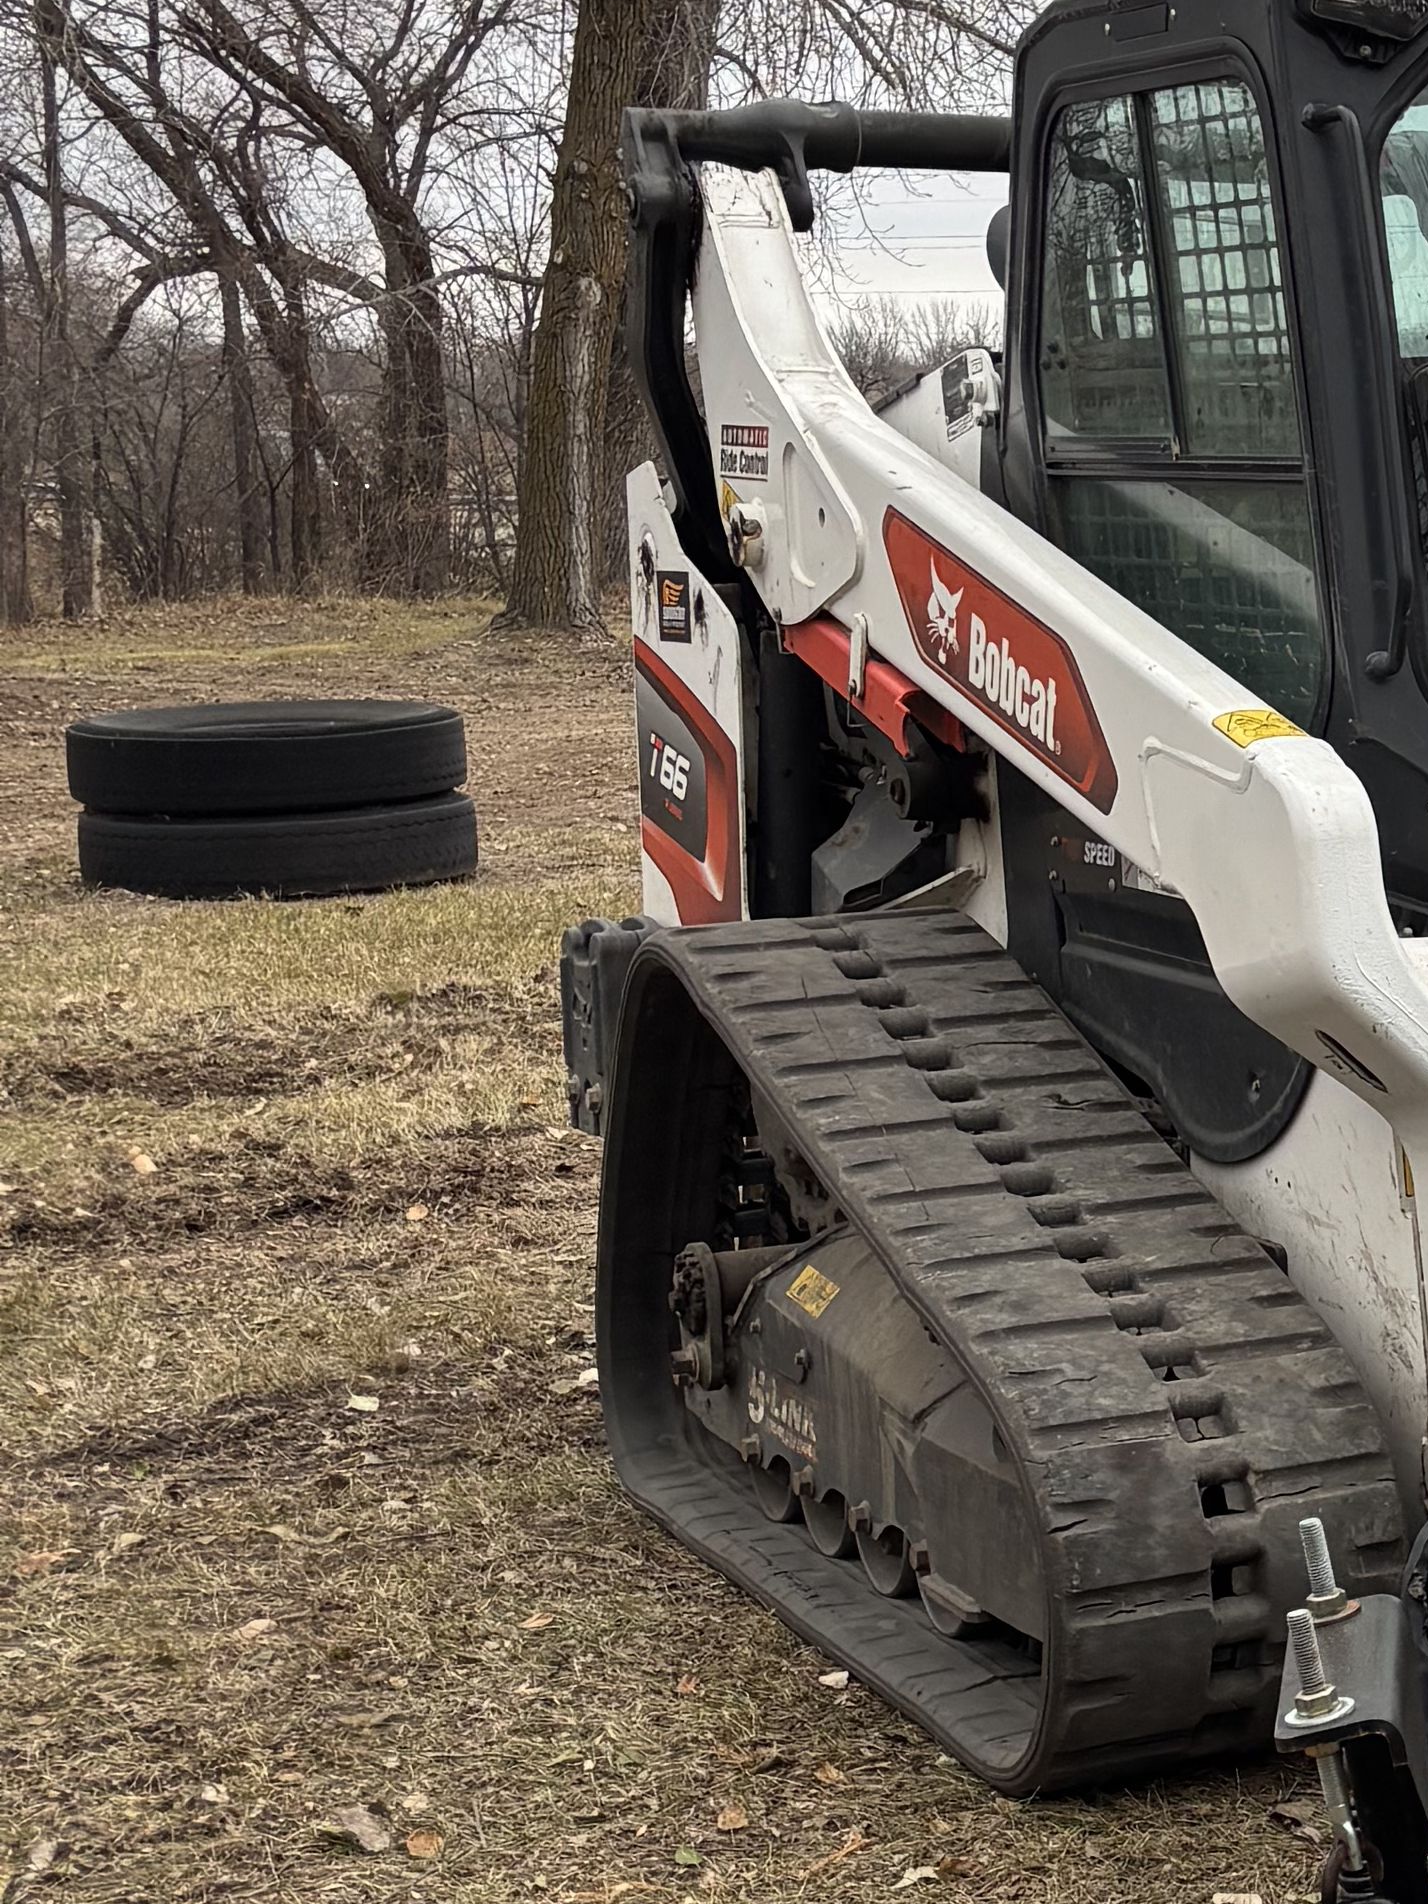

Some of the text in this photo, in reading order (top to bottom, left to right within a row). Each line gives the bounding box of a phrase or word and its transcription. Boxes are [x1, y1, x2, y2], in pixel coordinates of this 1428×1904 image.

[722, 428, 768, 446] AUTOMATIC
[720, 447, 738, 473] Ride
[968, 612, 1057, 752] Bobcat
[650, 732, 691, 801] T66
[1083, 841, 1116, 867] SPEED
